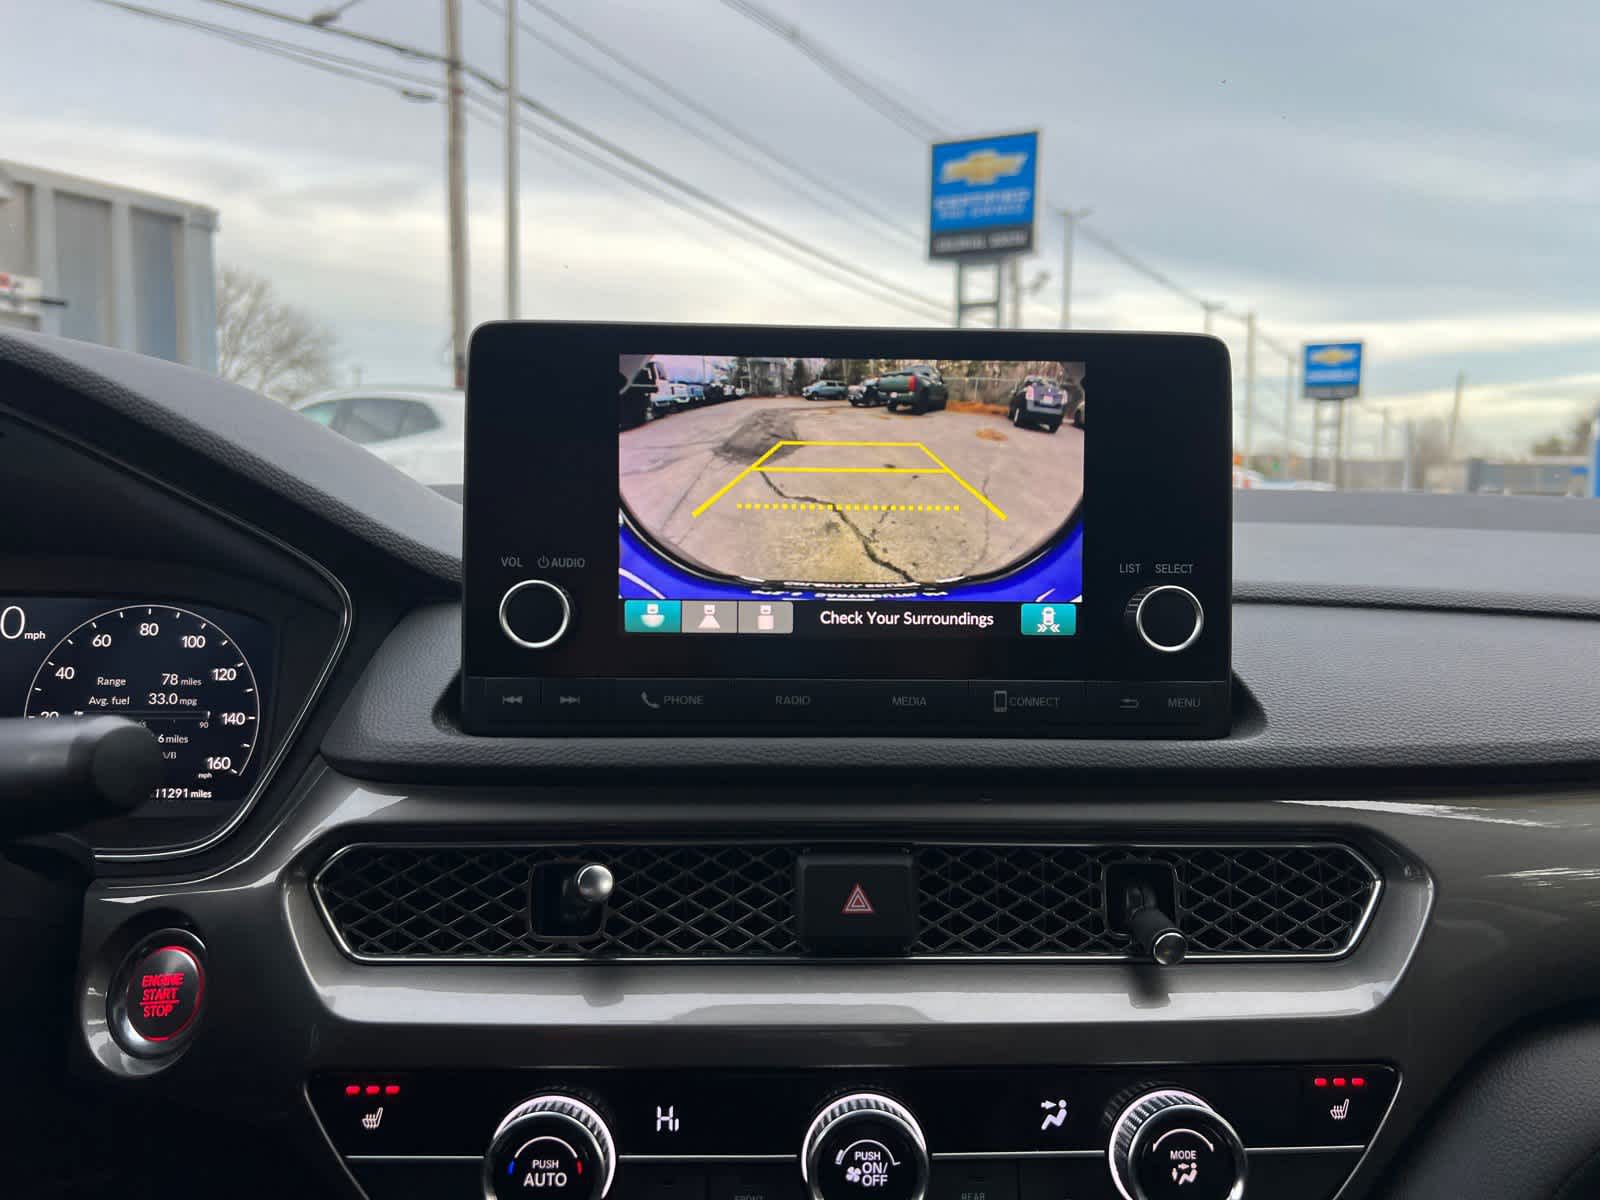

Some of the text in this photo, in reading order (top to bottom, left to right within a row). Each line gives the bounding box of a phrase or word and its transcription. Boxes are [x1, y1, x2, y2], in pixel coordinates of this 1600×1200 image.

[500, 557, 523, 568] VOL
[551, 557, 585, 568] AUDIO
[1119, 563, 1141, 574] LIST
[1155, 563, 1193, 574] SELECT
[0, 606, 45, 640] 0 mph
[820, 611, 994, 628] Check Your Surroundings
[140, 623, 159, 636] 80
[92, 634, 111, 647] 60
[182, 635, 206, 648] 100
[55, 667, 75, 679] 40
[213, 668, 237, 680] 120
[97, 674, 202, 688] Range 78 miles
[89, 693, 197, 706] Avg. fuel 33.0 mpg
[663, 696, 704, 705] PHONE
[775, 696, 811, 705] RADIO
[892, 697, 927, 706] MEDIA
[1009, 697, 1060, 707] CONNECT
[1168, 698, 1201, 708] MENU
[200, 720, 209, 729] 90
[222, 713, 246, 725] 140
[165, 734, 189, 744] miles
[206, 757, 231, 770] 160
[198, 772, 212, 780] mph
[190, 789, 212, 799] miles
[142, 973, 184, 987] ENGINE
[142, 988, 177, 1000] START
[143, 1005, 173, 1017] STOP
[855, 1151, 881, 1160] PUSH
[1170, 1150, 1197, 1160] MODE
[532, 1160, 560, 1169] PUSH
[862, 1161, 889, 1174] ON/
[523, 1172, 568, 1188] AUTO
[862, 1174, 889, 1187] OFF
